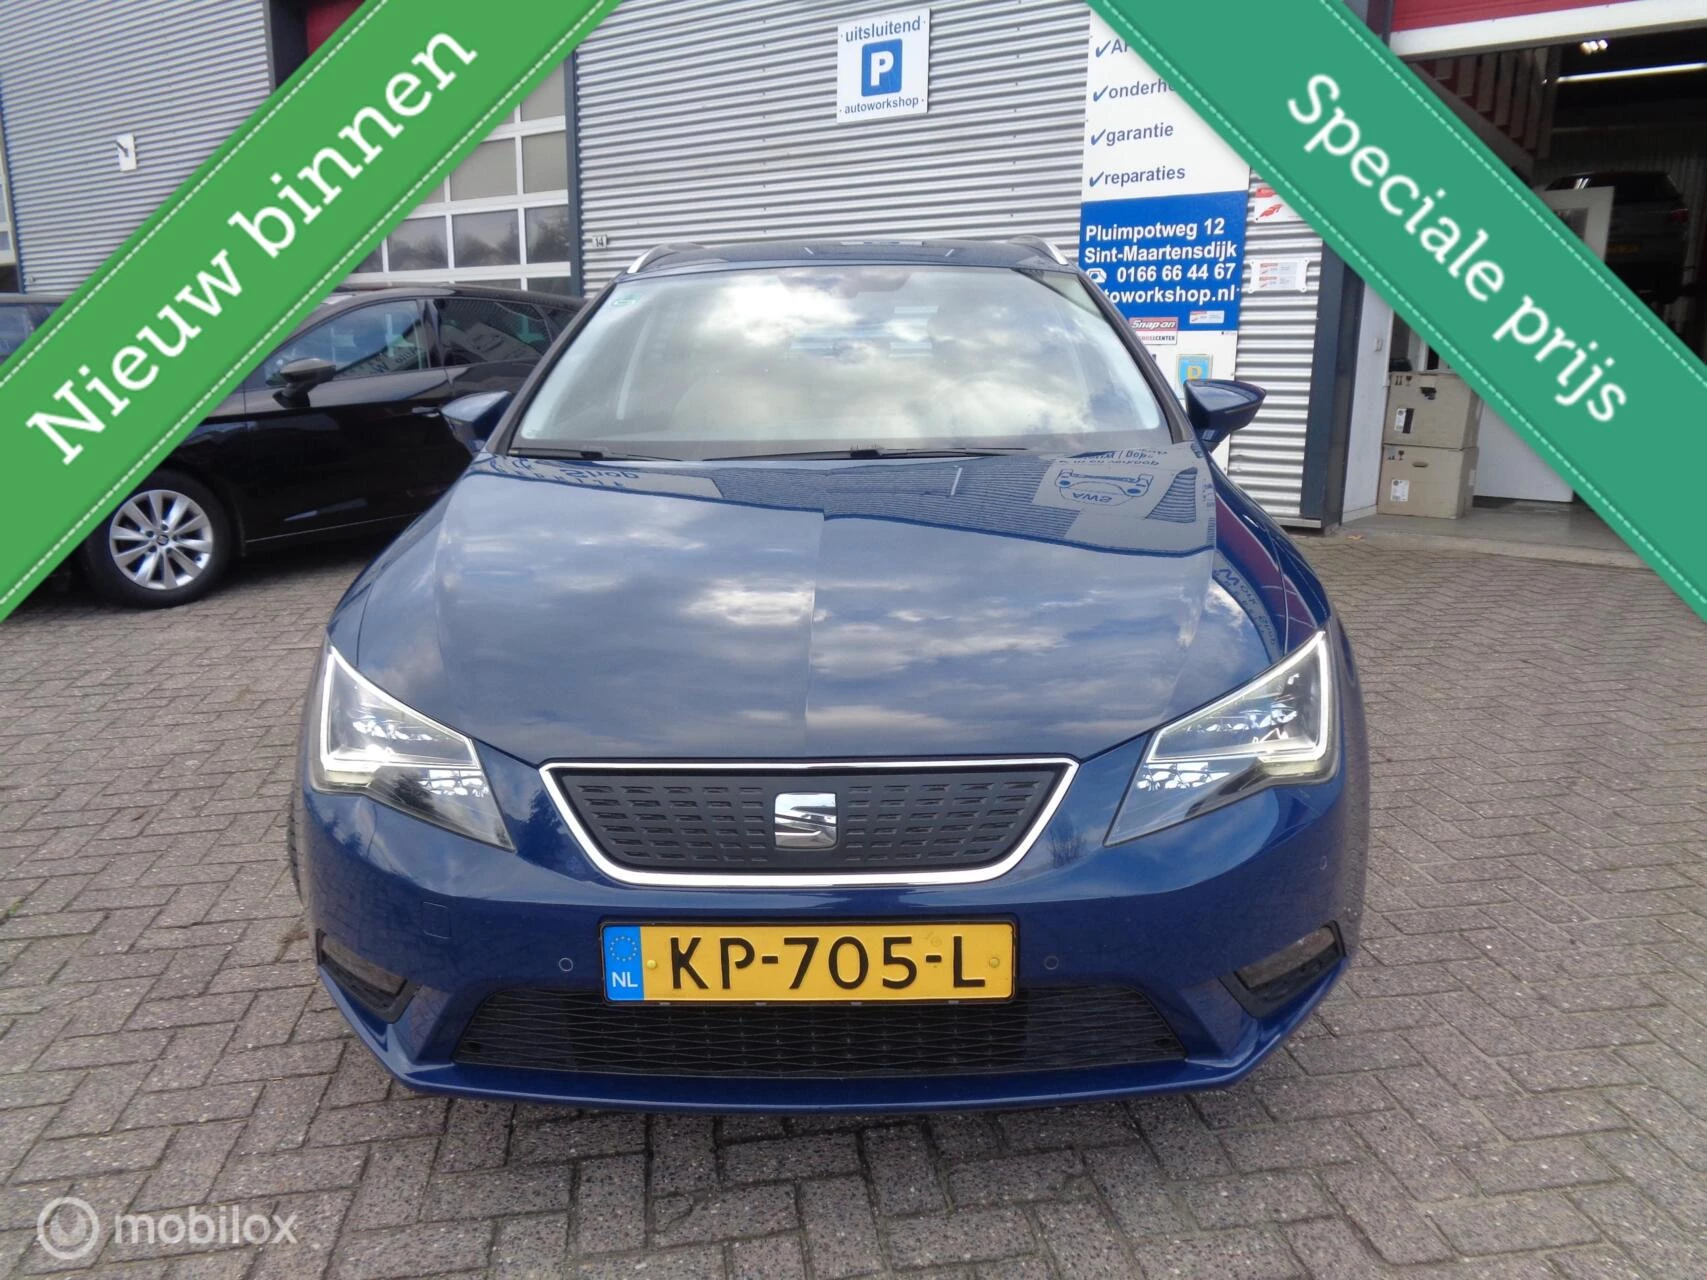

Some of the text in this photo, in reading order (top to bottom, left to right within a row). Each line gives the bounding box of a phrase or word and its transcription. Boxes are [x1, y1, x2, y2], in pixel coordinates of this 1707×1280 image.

[845, 16, 921, 42] uitsluitend
[870, 50, 894, 87] P
[844, 96, 919, 114] autoworkshop
[1106, 122, 1174, 146] garantie
[1104, 165, 1186, 187] reparaties
[1085, 217, 1225, 243] Pluimpotweg 12
[1084, 241, 1237, 264] Sint-Maartensdijk
[1116, 262, 1237, 283] 0166 66 44 67
[611, 935, 987, 990] NL KP-705-L
